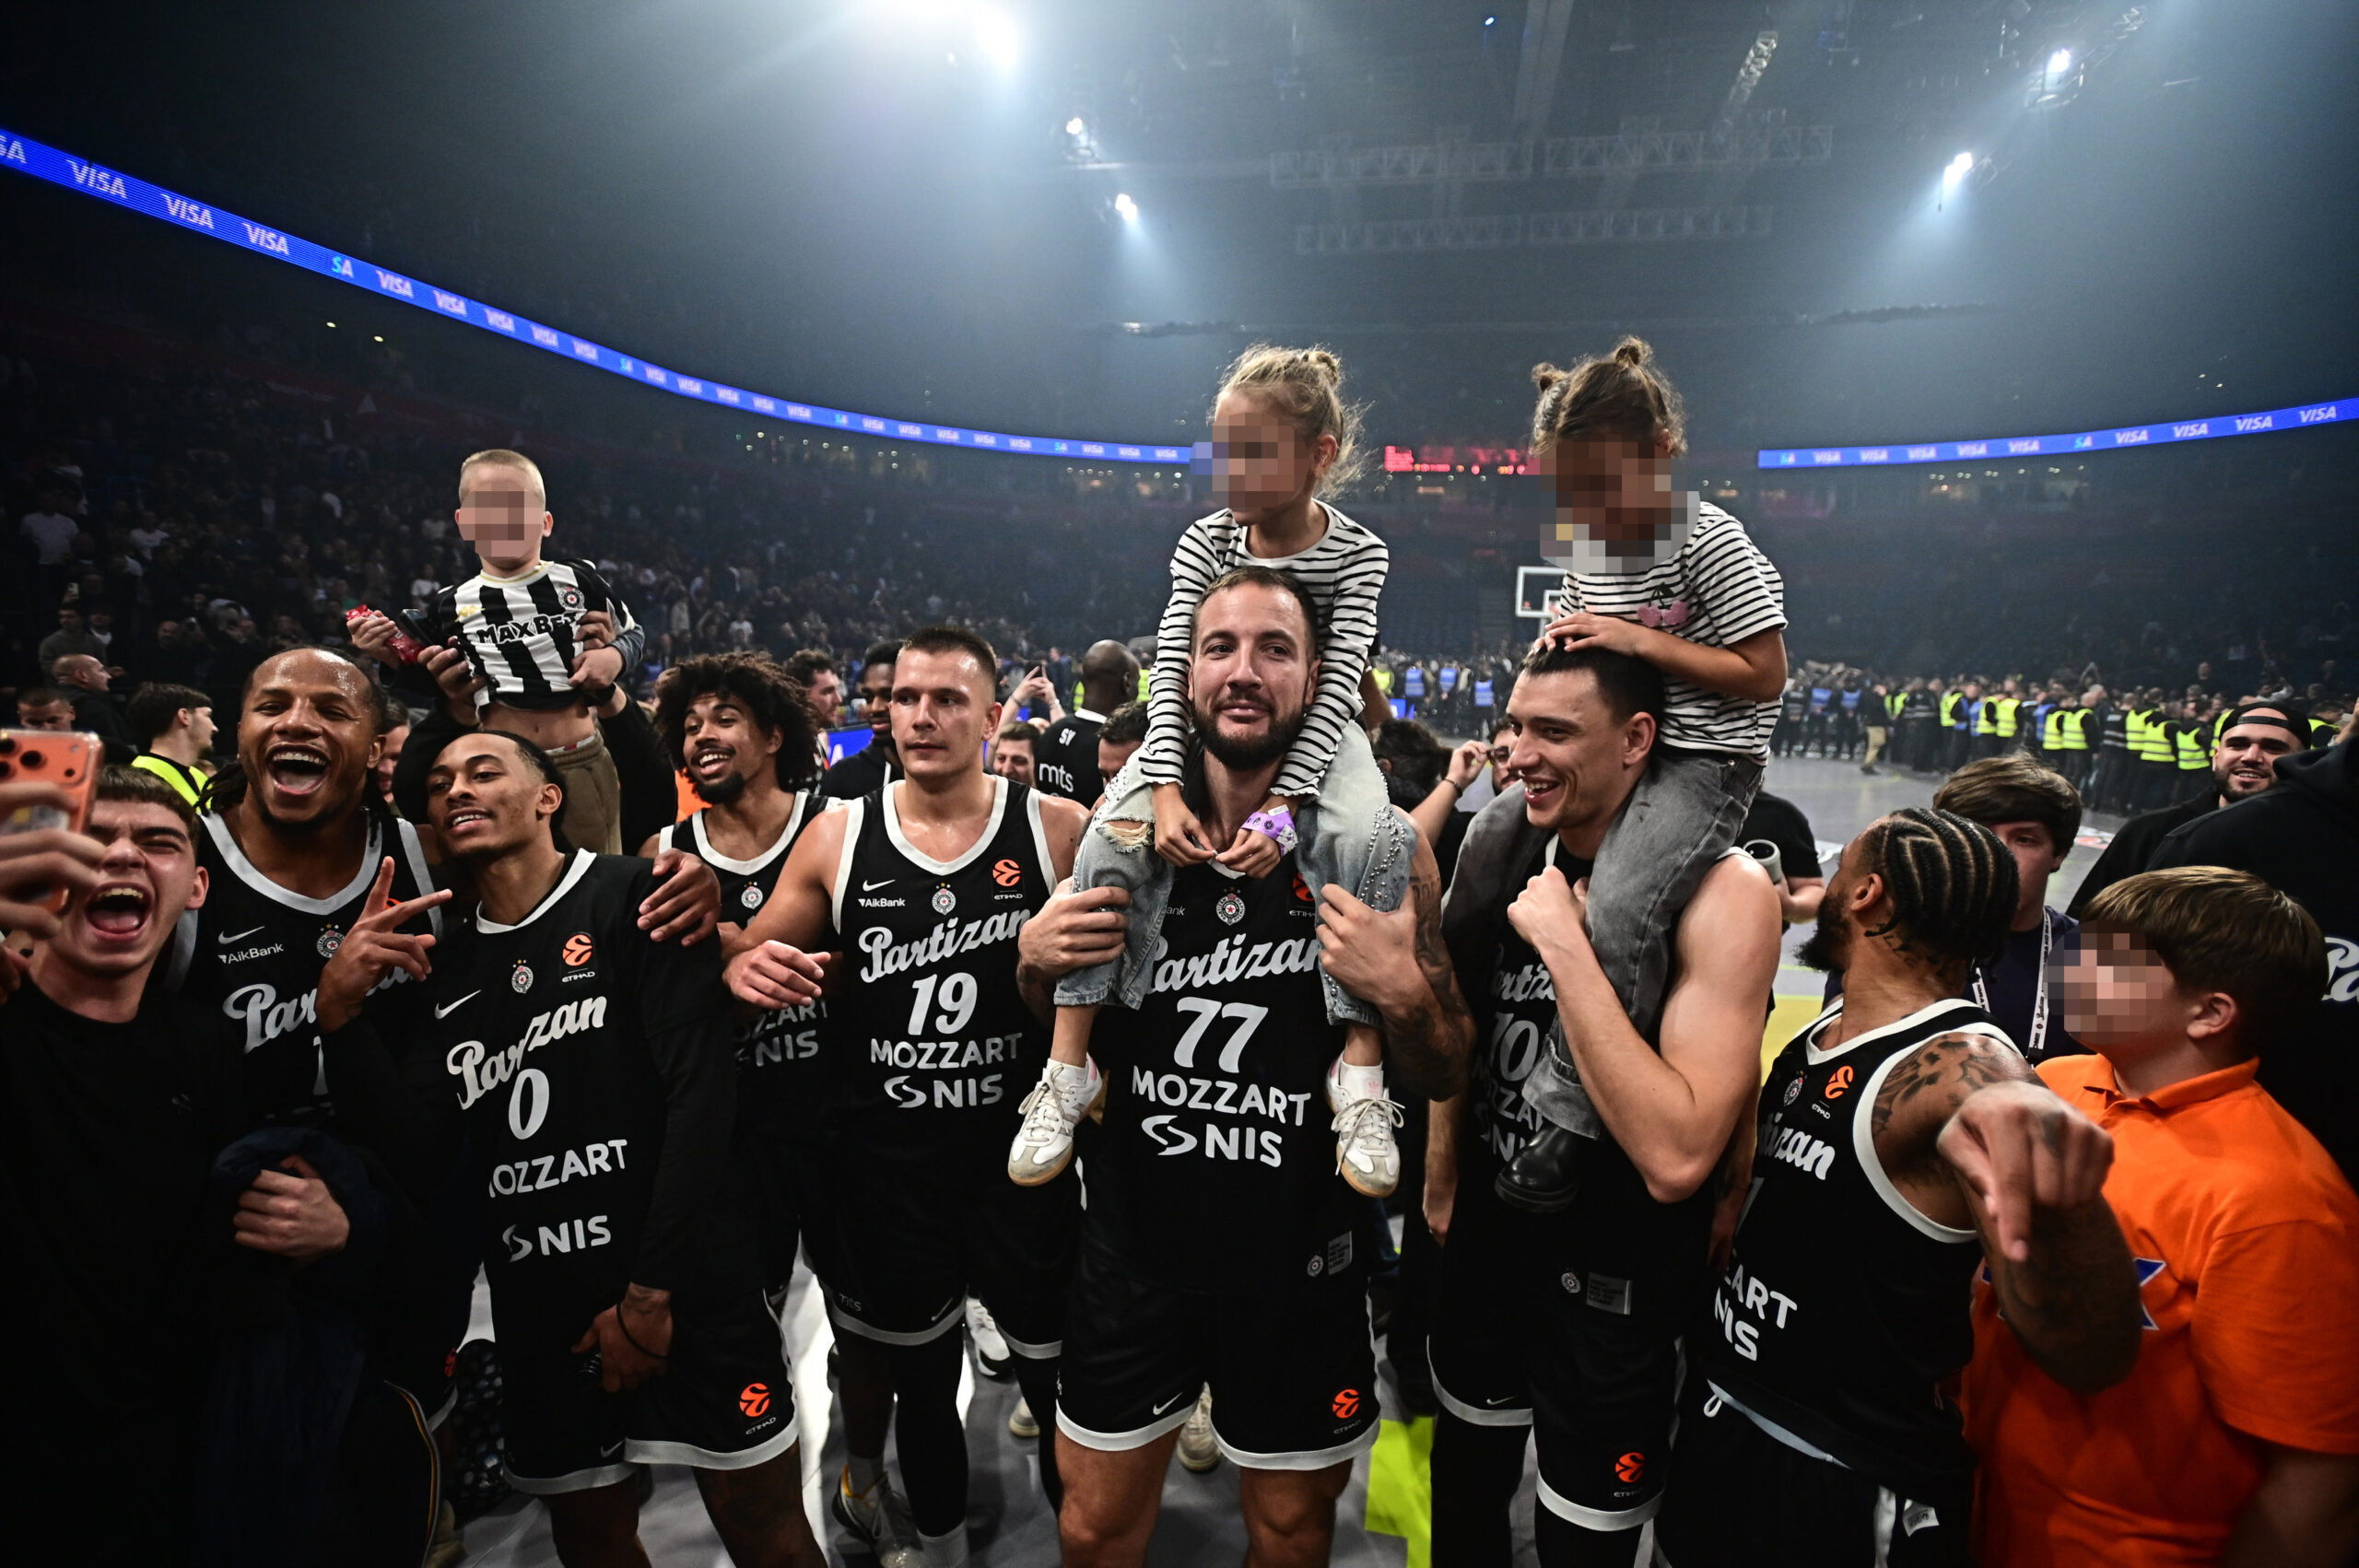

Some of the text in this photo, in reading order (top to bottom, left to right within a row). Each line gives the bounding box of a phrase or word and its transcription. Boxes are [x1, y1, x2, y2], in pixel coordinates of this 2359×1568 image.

[66, 159, 127, 199] VISA
[160, 193, 215, 229] VISA
[241, 222, 290, 255] VISA
[376, 270, 414, 298] VISA
[433, 289, 467, 317] VISA
[484, 308, 515, 333] VISA
[2115, 429, 2150, 445] VISA
[2172, 423, 2210, 439] VISA
[2235, 415, 2273, 432] VISA
[2299, 405, 2337, 423] VISA
[475, 611, 580, 645] MAXBET
[1039, 762, 1074, 793] mts
[865, 896, 907, 908] AikBank
[228, 942, 285, 965] AikBank
[858, 908, 1031, 984] Partizan
[561, 970, 596, 983] ETIHAD
[907, 971, 979, 1036] 19
[754, 1029, 820, 1068] NIS
[870, 1032, 1024, 1070] MOZZART
[1173, 996, 1270, 1074] 77
[508, 1068, 550, 1141] 0
[933, 1073, 1004, 1109] NIS
[1132, 1064, 1312, 1128] MOZZART
[1204, 1122, 1284, 1168] NIS
[488, 1139, 628, 1199] OZZART
[538, 1214, 612, 1257] NIS
[1714, 1286, 1760, 1362] NIS
[745, 1416, 777, 1435] ETIHAD
